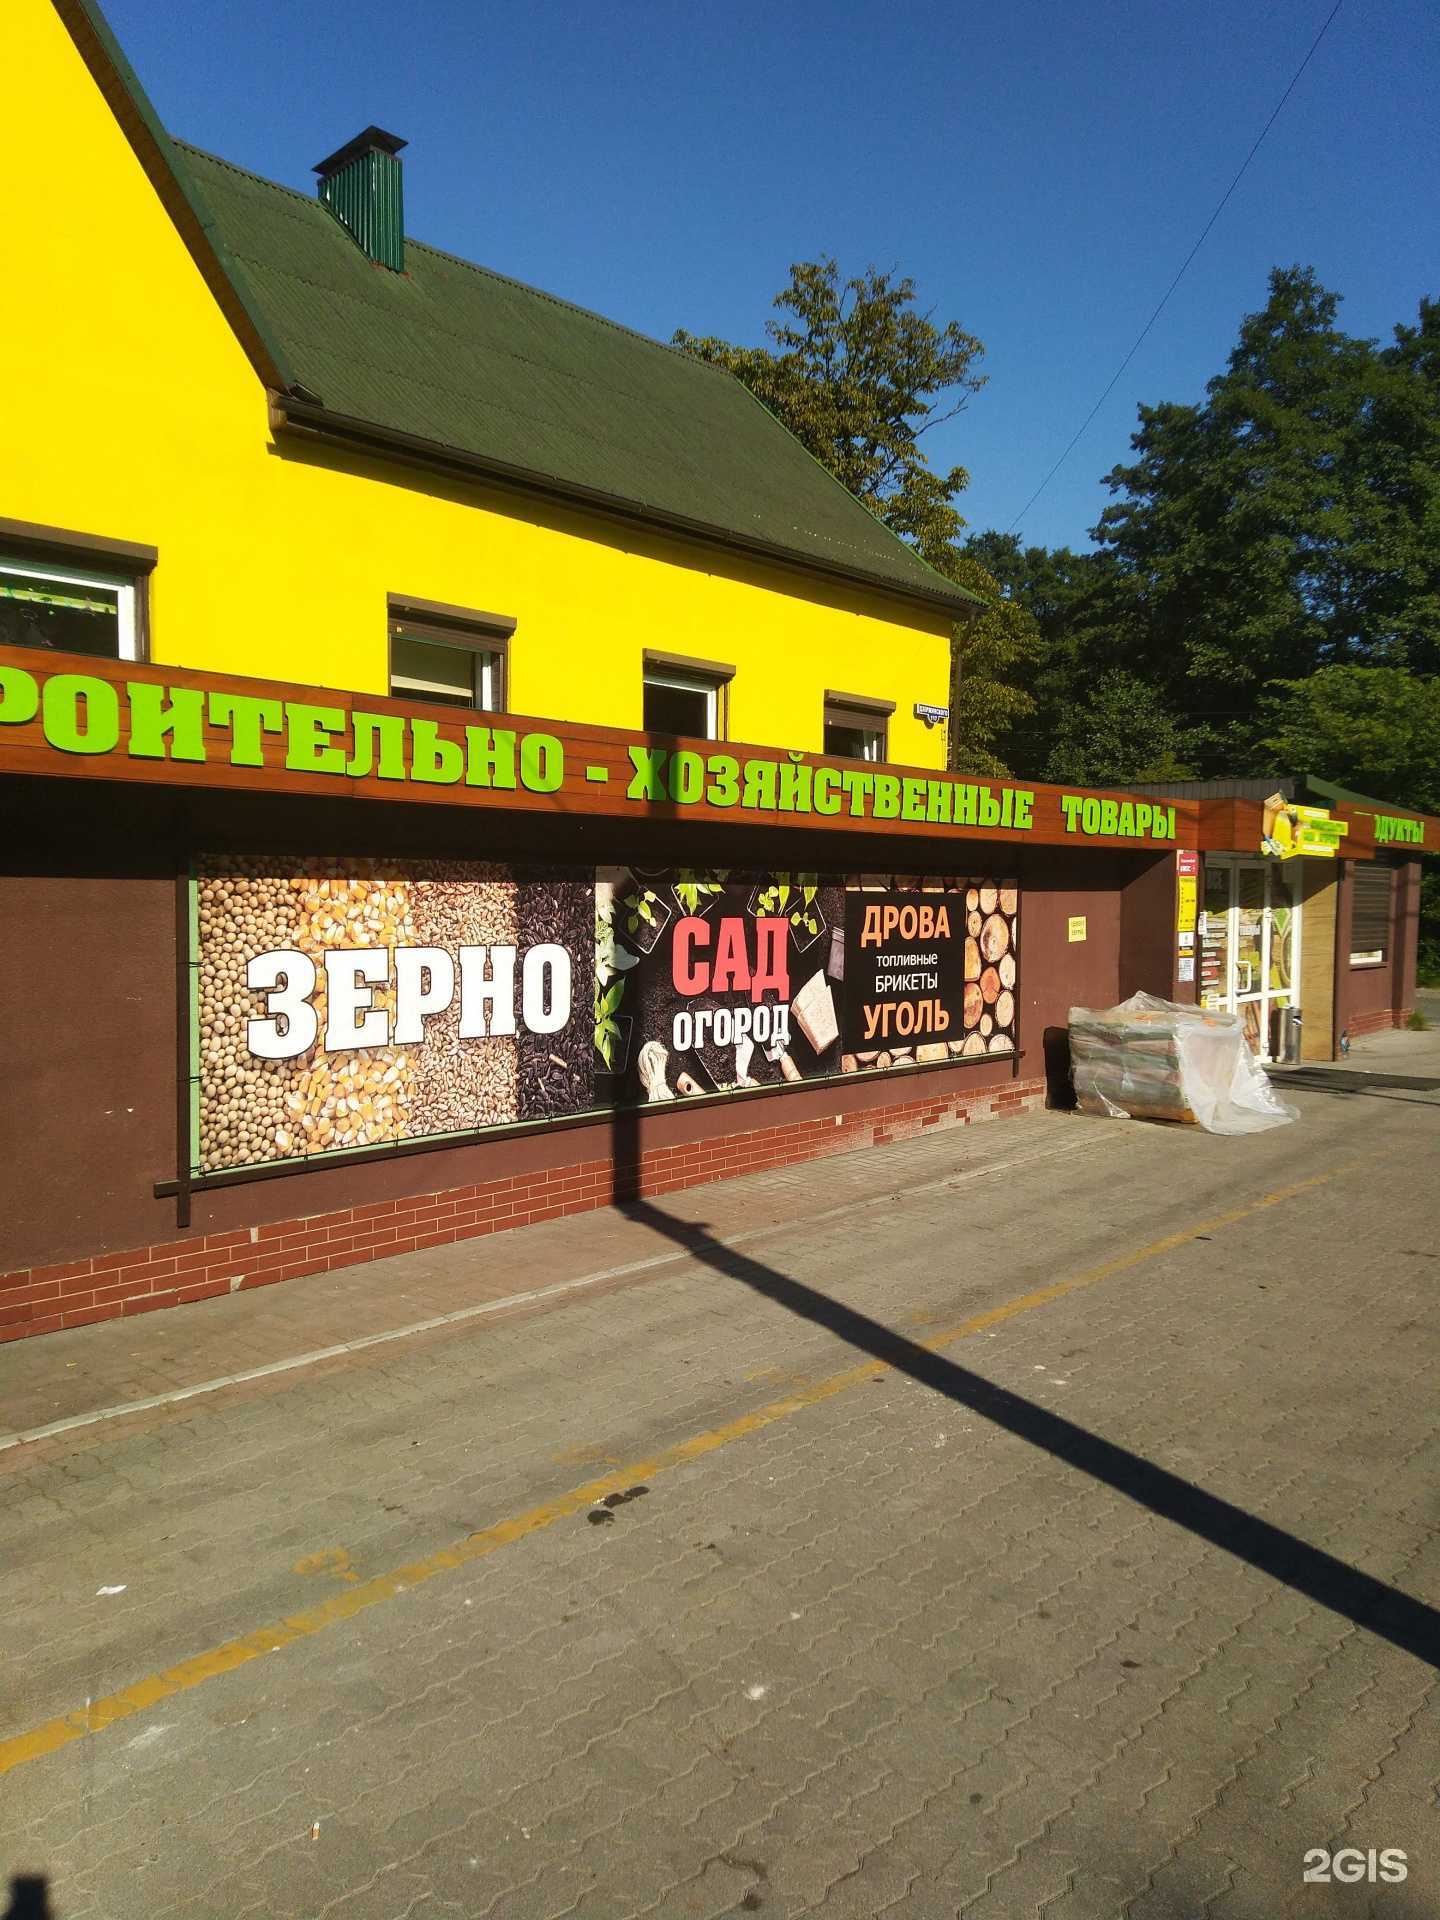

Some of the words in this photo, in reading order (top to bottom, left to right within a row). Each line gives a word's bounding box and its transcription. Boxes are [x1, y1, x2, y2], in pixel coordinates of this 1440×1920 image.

[627, 746, 1034, 830] ХОЗЯЙСТВЕННЫЕ
[1061, 796, 1176, 840] ТОВАРЫ
[861, 905, 951, 948] ДРОВА
[672, 916, 790, 1003] САД
[876, 953, 938, 968] топливные
[247, 943, 571, 1060] ЗЕРНО
[875, 972, 938, 993] БРИКЕТЫ
[672, 1004, 791, 1051] ОГОРОД
[863, 999, 950, 1040] УГОЛЬ
